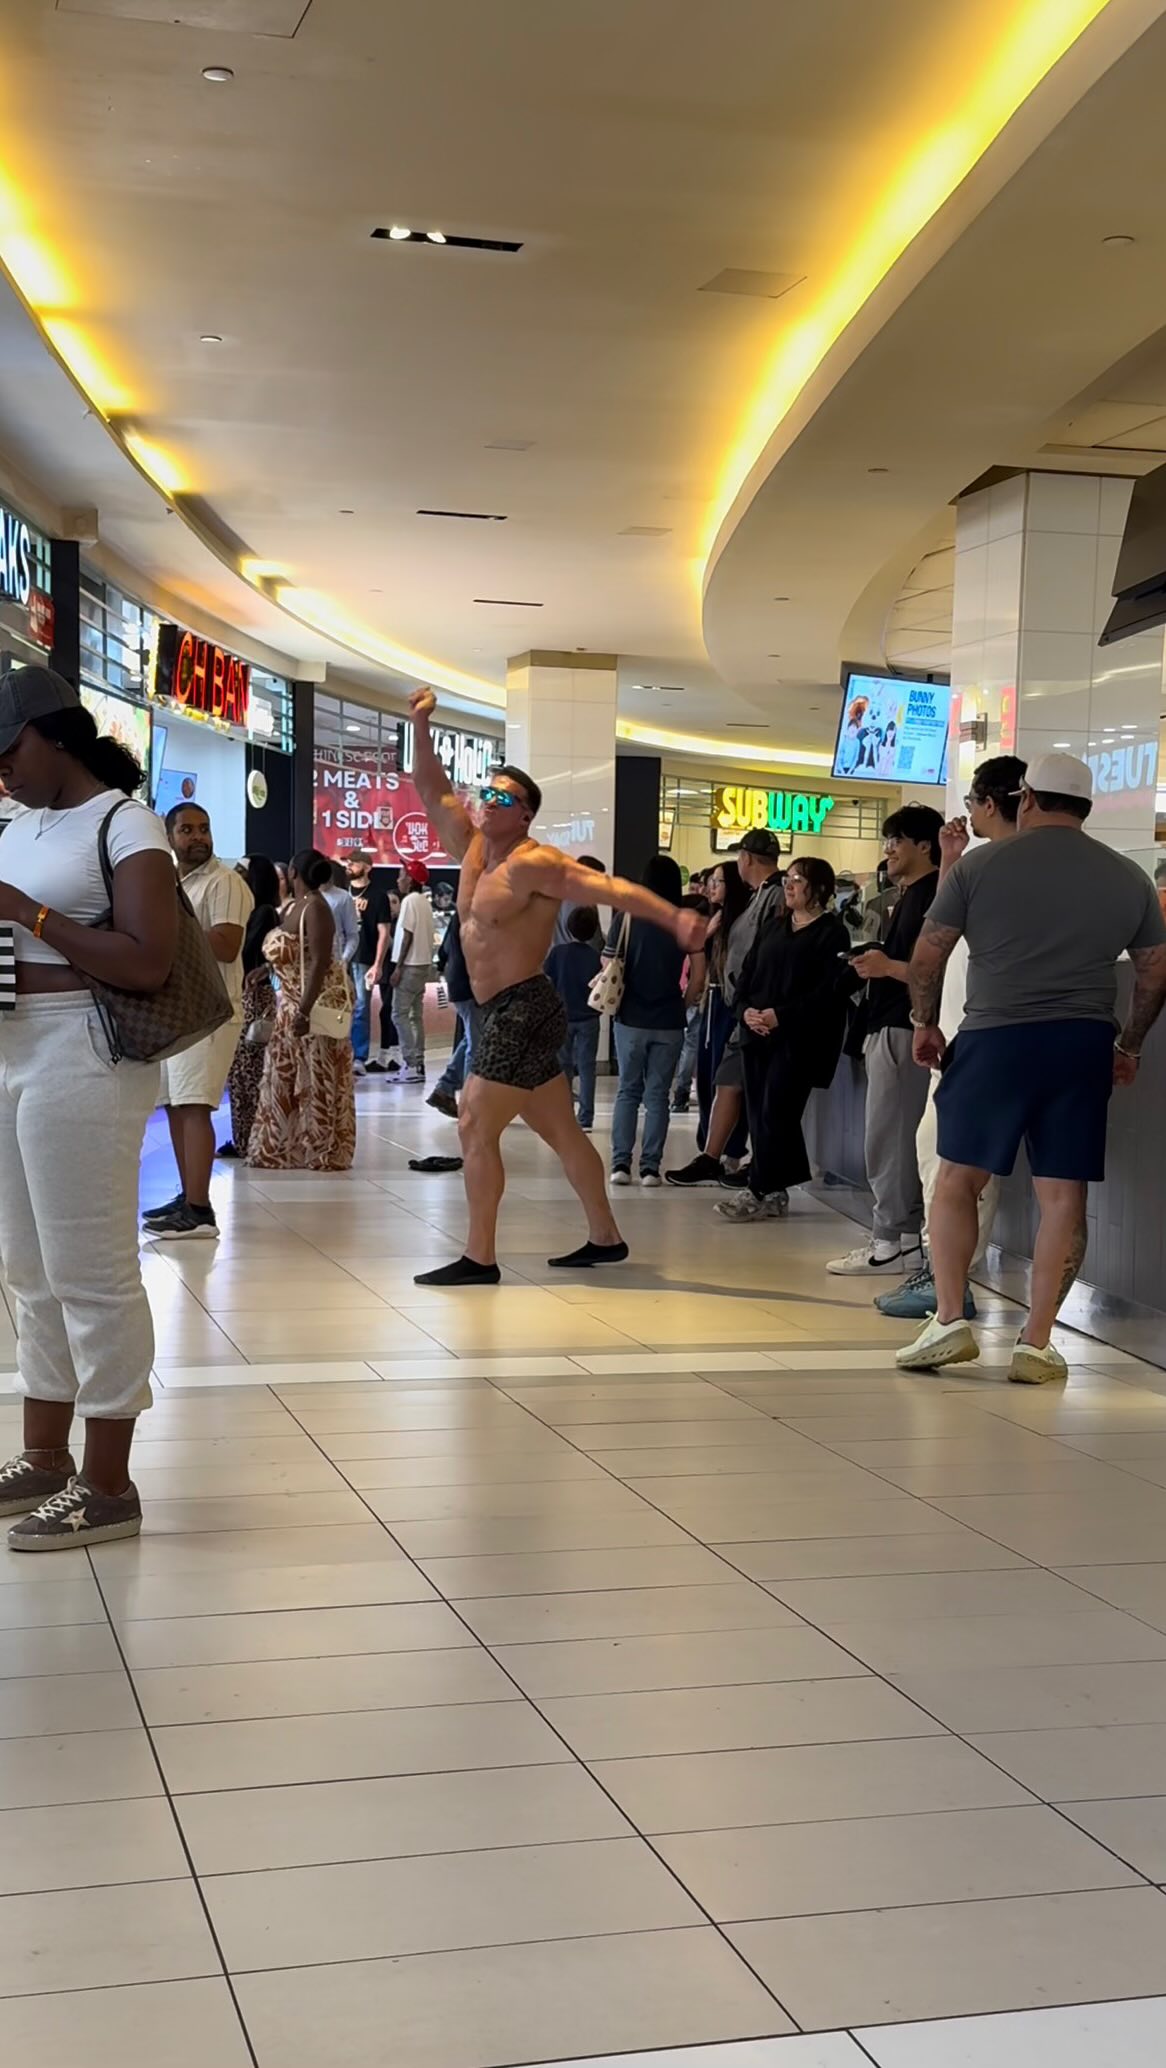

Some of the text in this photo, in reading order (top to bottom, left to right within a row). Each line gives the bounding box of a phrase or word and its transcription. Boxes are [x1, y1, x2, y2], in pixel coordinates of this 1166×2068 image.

[909, 690, 935, 703] BUNNY
[907, 703, 937, 718] PHOTOS
[323, 770, 400, 790] MEATS
[344, 791, 360, 809] &
[322, 810, 331, 828] 1
[717, 787, 834, 833] SUBWAY
